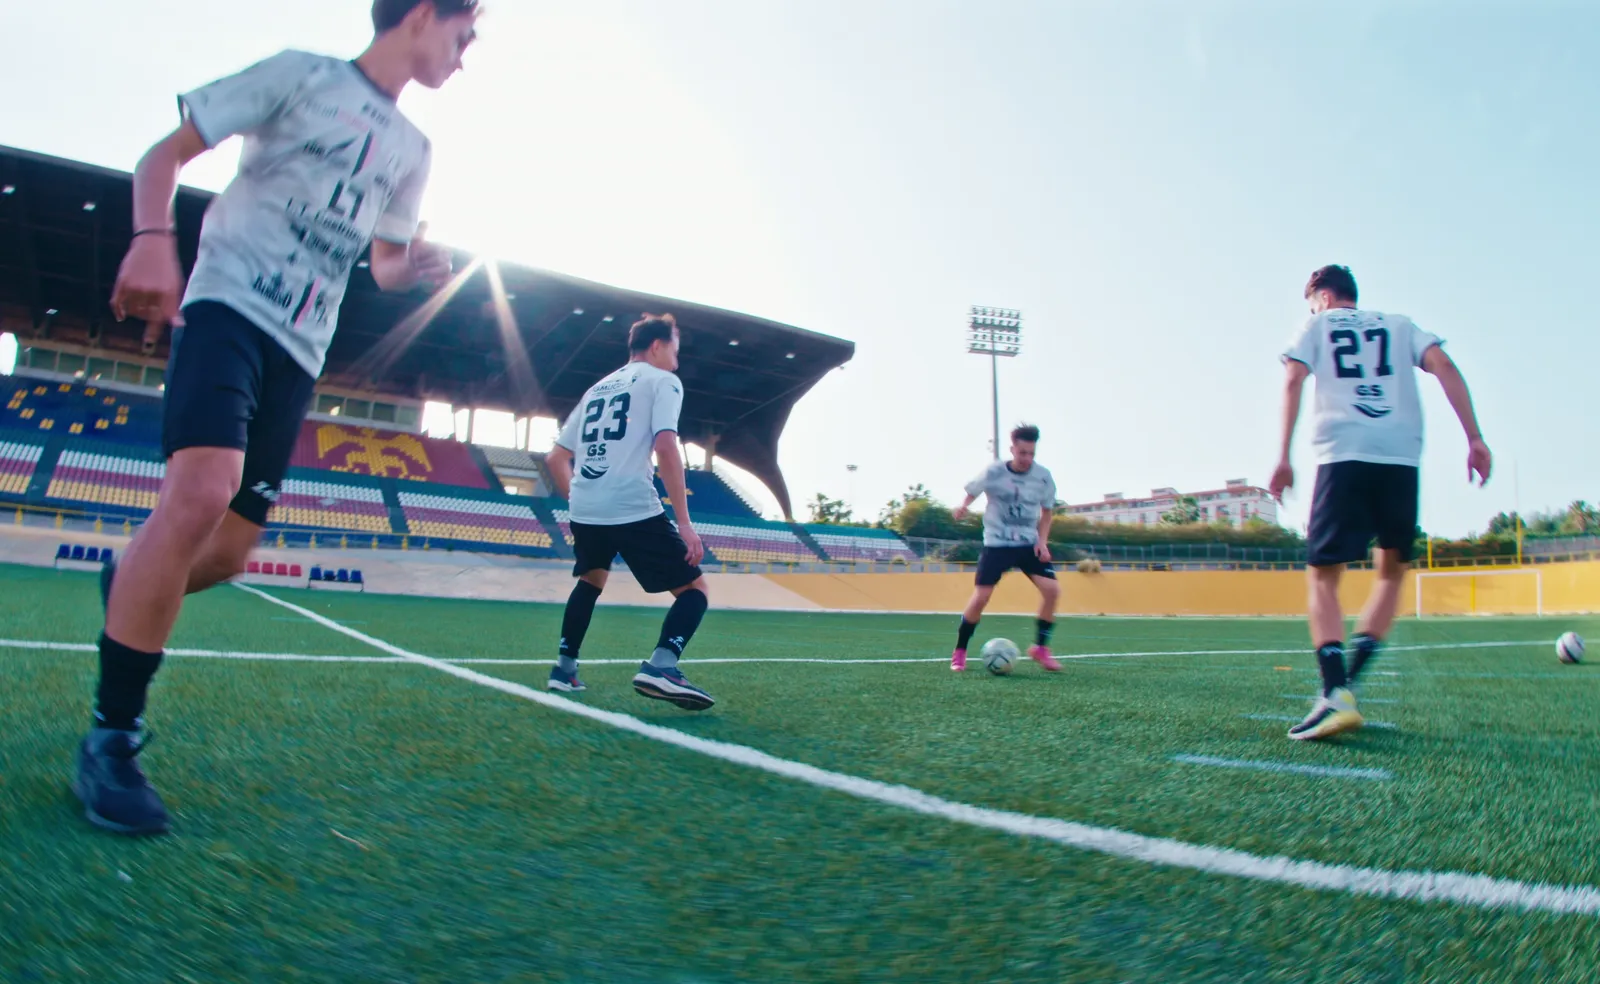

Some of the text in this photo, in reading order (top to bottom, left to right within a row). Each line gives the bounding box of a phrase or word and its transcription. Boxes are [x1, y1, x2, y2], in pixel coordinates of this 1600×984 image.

[1329, 328, 1393, 378] 27
[1354, 384, 1384, 396] GS
[581, 392, 631, 443] 23
[587, 443, 606, 457] GS
